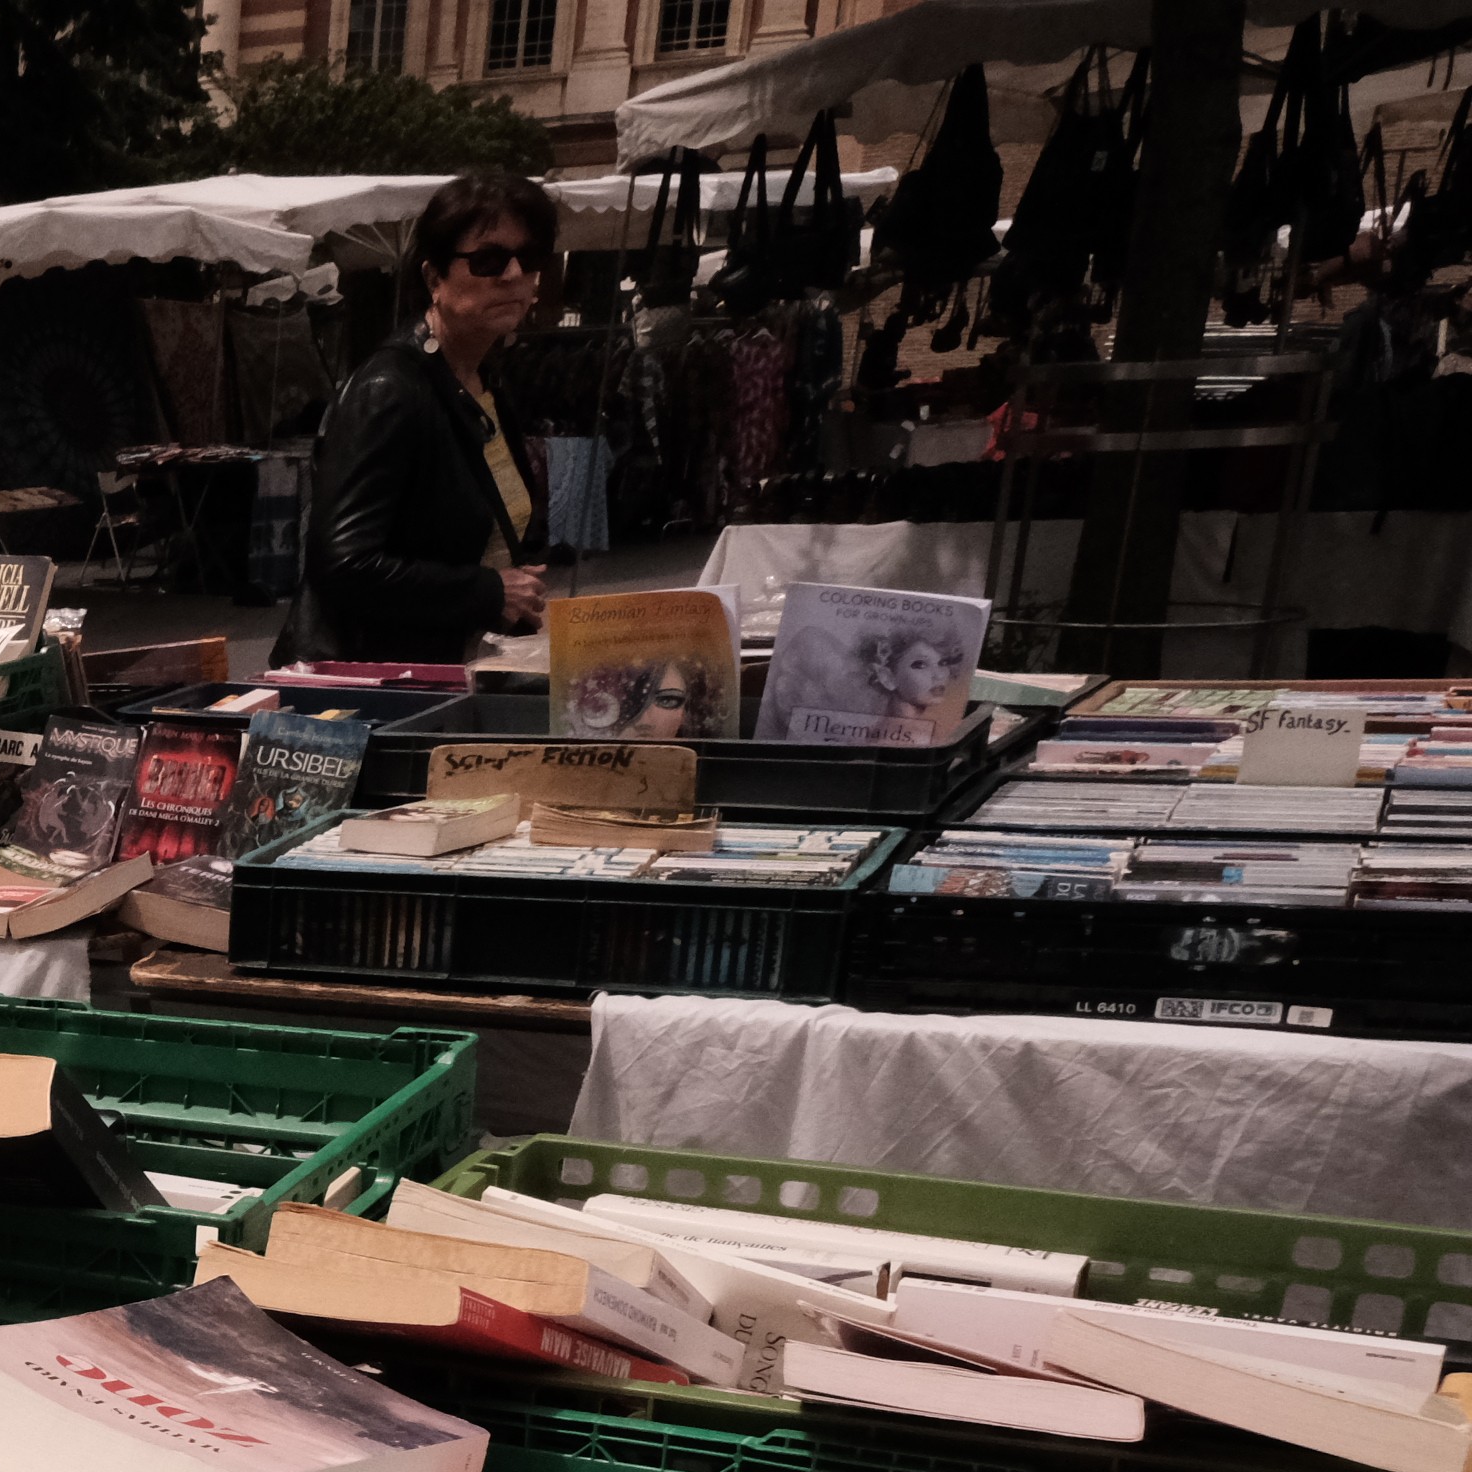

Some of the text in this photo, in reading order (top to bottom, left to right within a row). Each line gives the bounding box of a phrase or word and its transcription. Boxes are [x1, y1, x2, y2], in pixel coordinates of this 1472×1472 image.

[819, 591, 954, 617] COLORING BOOKS
[835, 608, 860, 620] FOR
[569, 605, 646, 626] Bohemian
[51, 729, 138, 756] MYSTIQUE
[1076, 1002, 1135, 1013] LL 6410
[1210, 1002, 1254, 1016] IFCO
[541, 1326, 631, 1378] MAUVAISE MAIN
